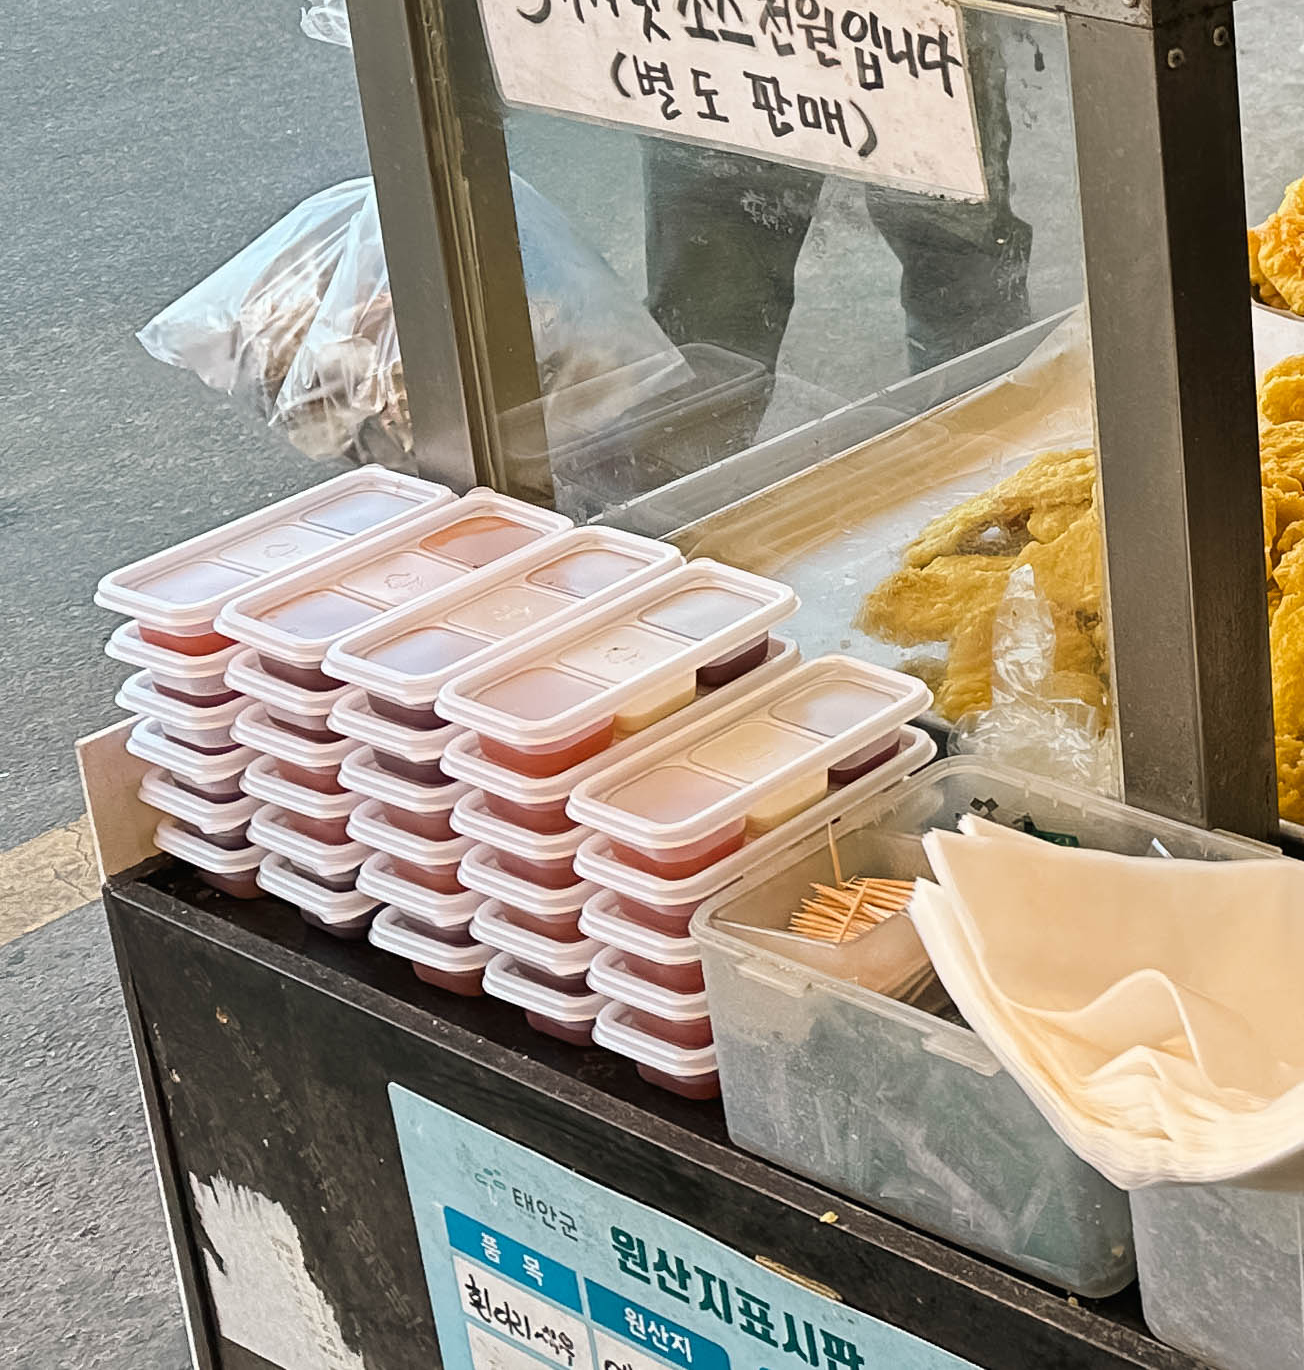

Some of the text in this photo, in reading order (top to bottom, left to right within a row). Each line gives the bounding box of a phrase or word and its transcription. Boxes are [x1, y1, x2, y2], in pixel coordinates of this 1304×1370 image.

[742, 69, 879, 159] 판매)
[512, 1186, 579, 1242] 태안군
[610, 1225, 866, 1370] 원산지표시판
[623, 1306, 693, 1364] 원산지
